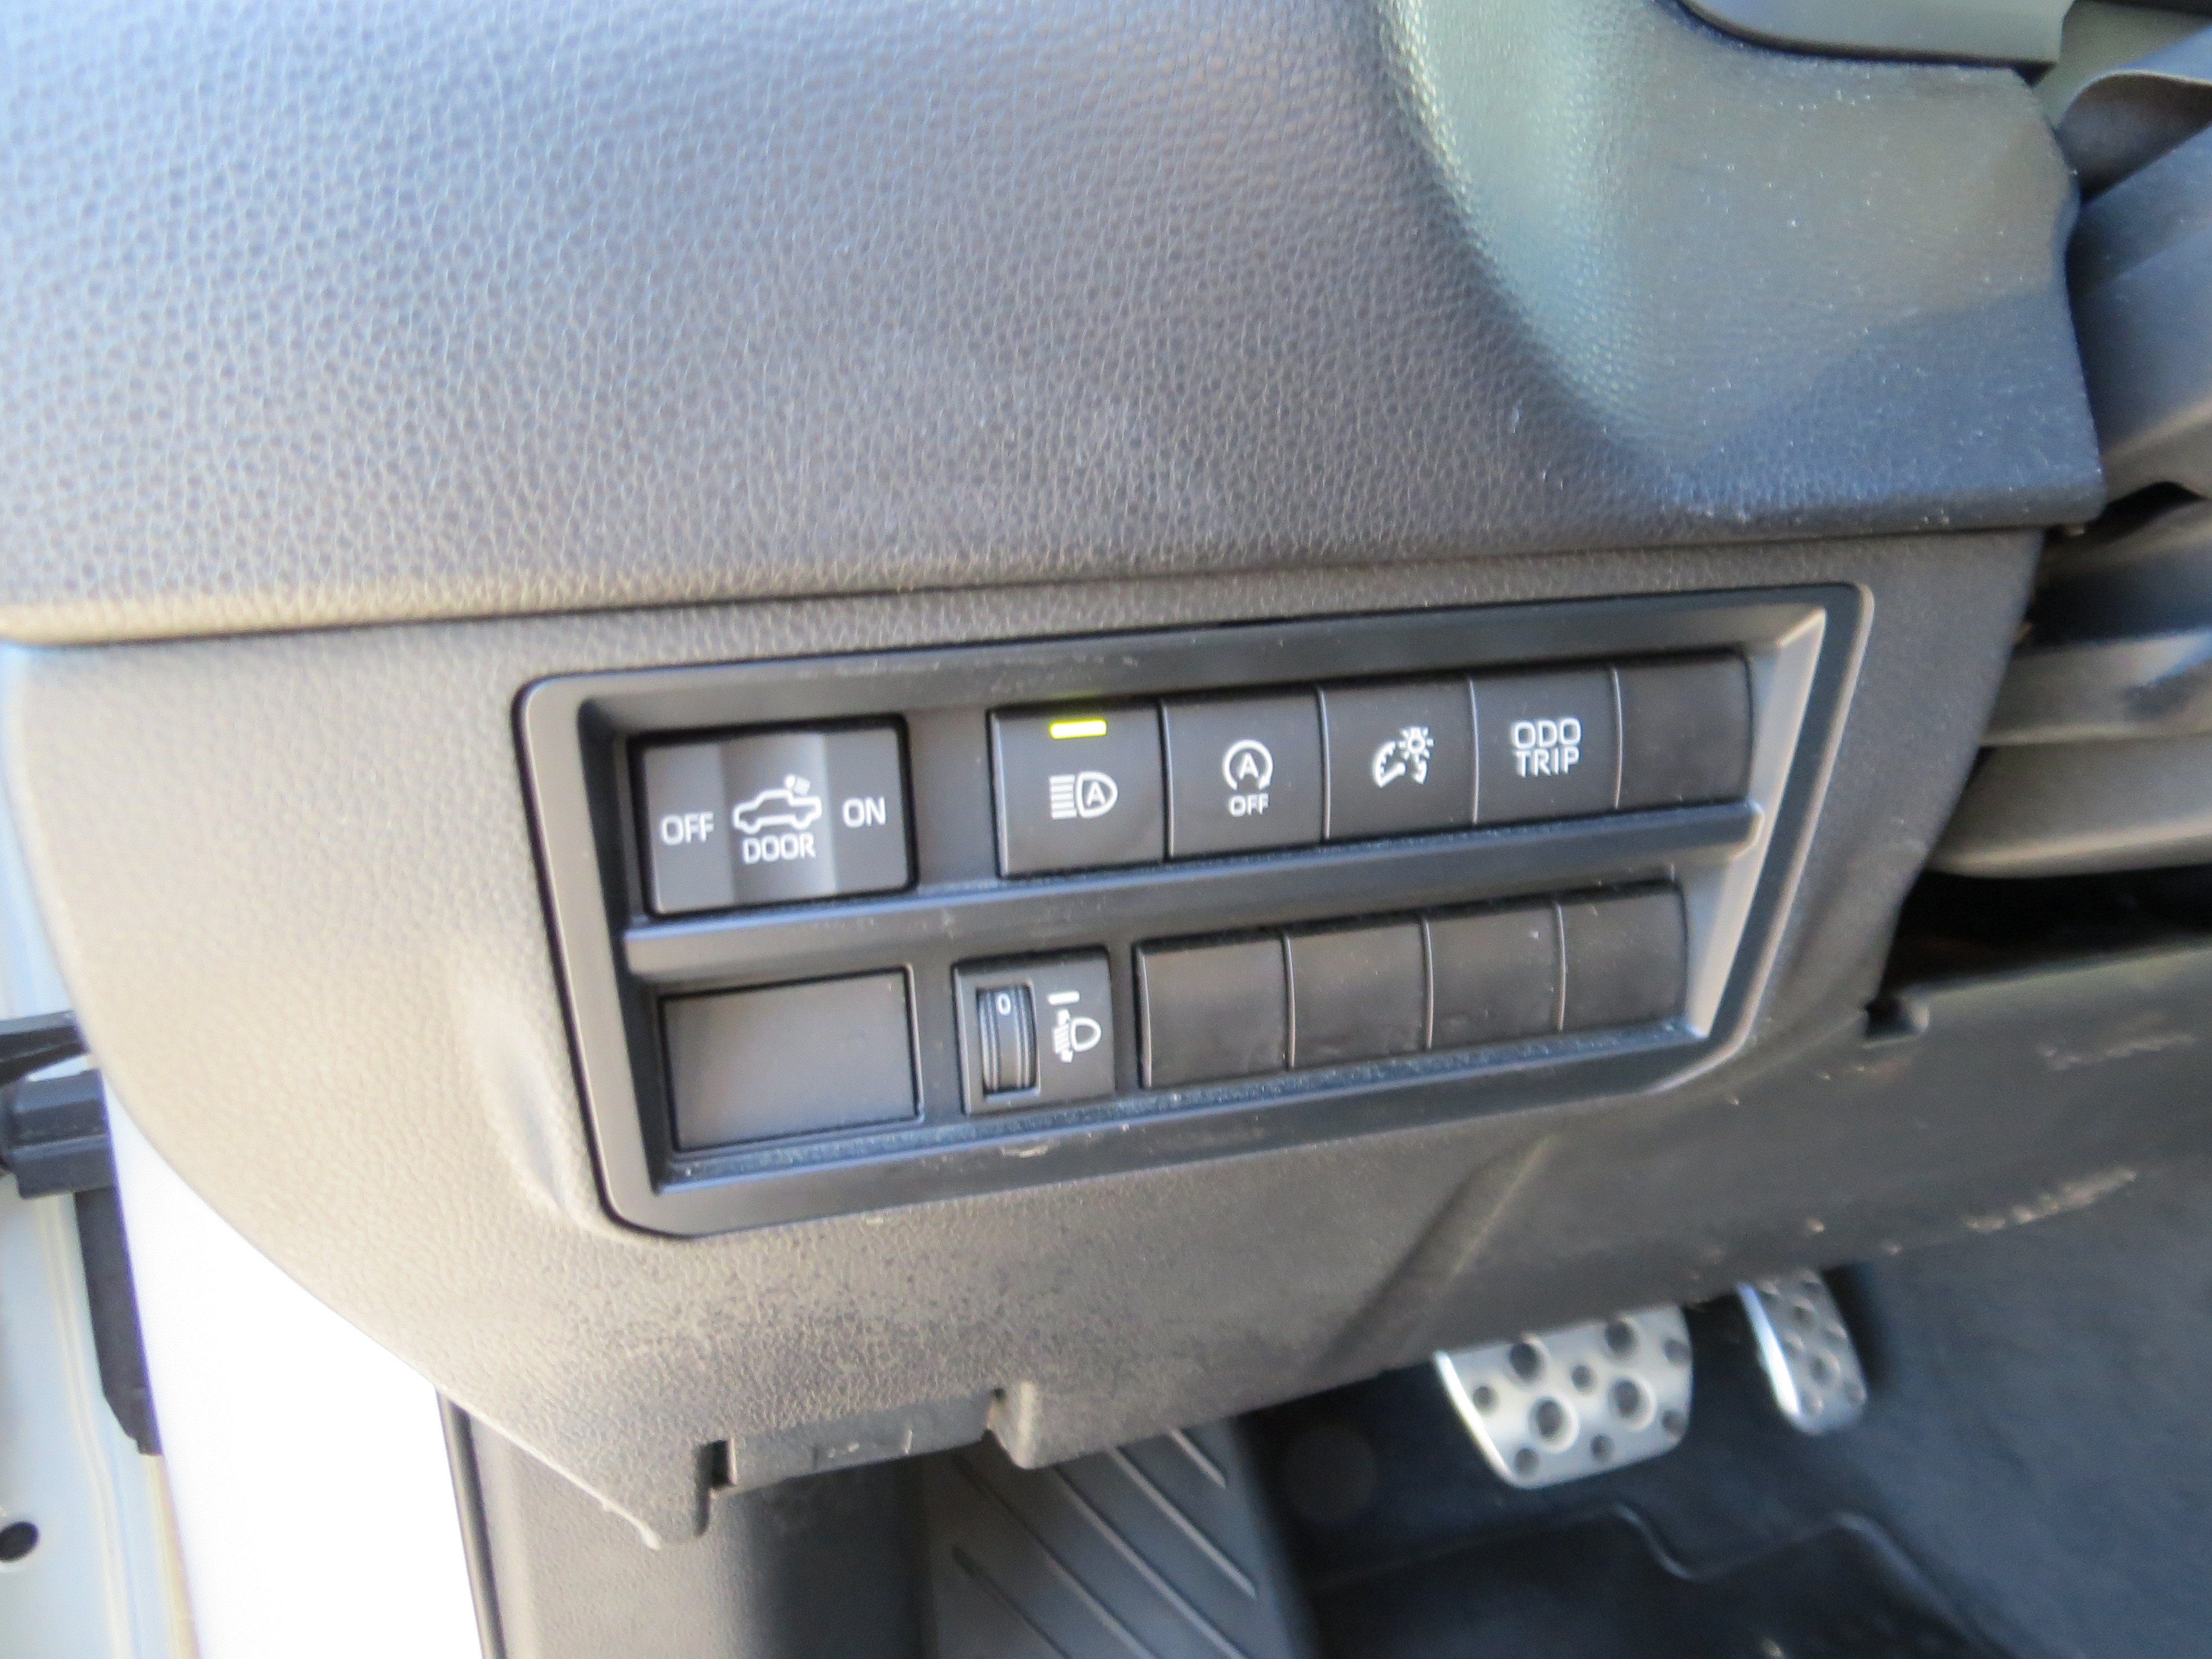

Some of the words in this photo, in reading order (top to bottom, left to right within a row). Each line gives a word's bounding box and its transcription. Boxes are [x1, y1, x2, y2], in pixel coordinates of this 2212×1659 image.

[1512, 718, 1582, 749] ODO
[1514, 746, 1580, 778] TRIP
[842, 796, 886, 828] ON
[1228, 792, 1269, 817] OFF
[662, 811, 714, 845] OFF
[742, 833, 816, 864] DOOR
[998, 993, 1011, 1015] 0
